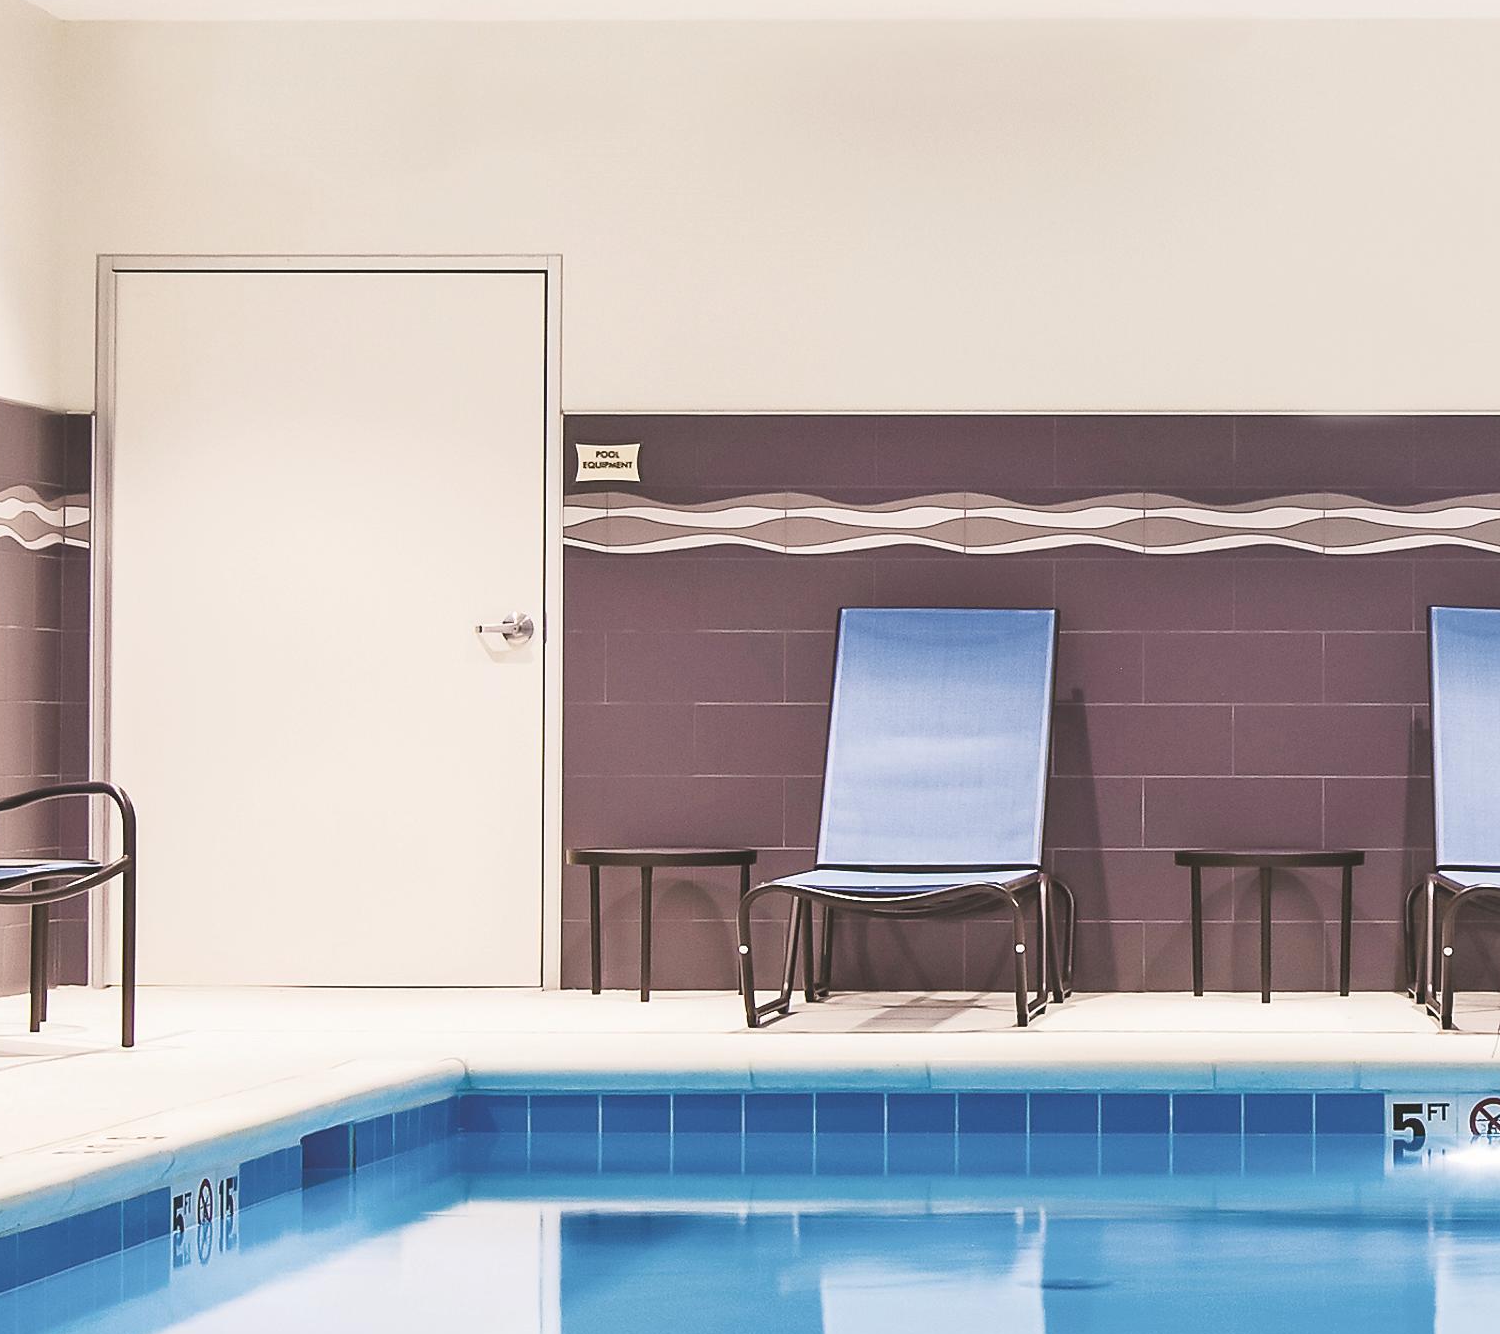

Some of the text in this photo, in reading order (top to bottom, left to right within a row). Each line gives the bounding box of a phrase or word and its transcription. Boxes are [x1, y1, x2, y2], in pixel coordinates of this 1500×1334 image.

[595, 450, 620, 459] POOL
[582, 461, 633, 469] EQUIPMENT
[1428, 1103, 1450, 1121] FT
